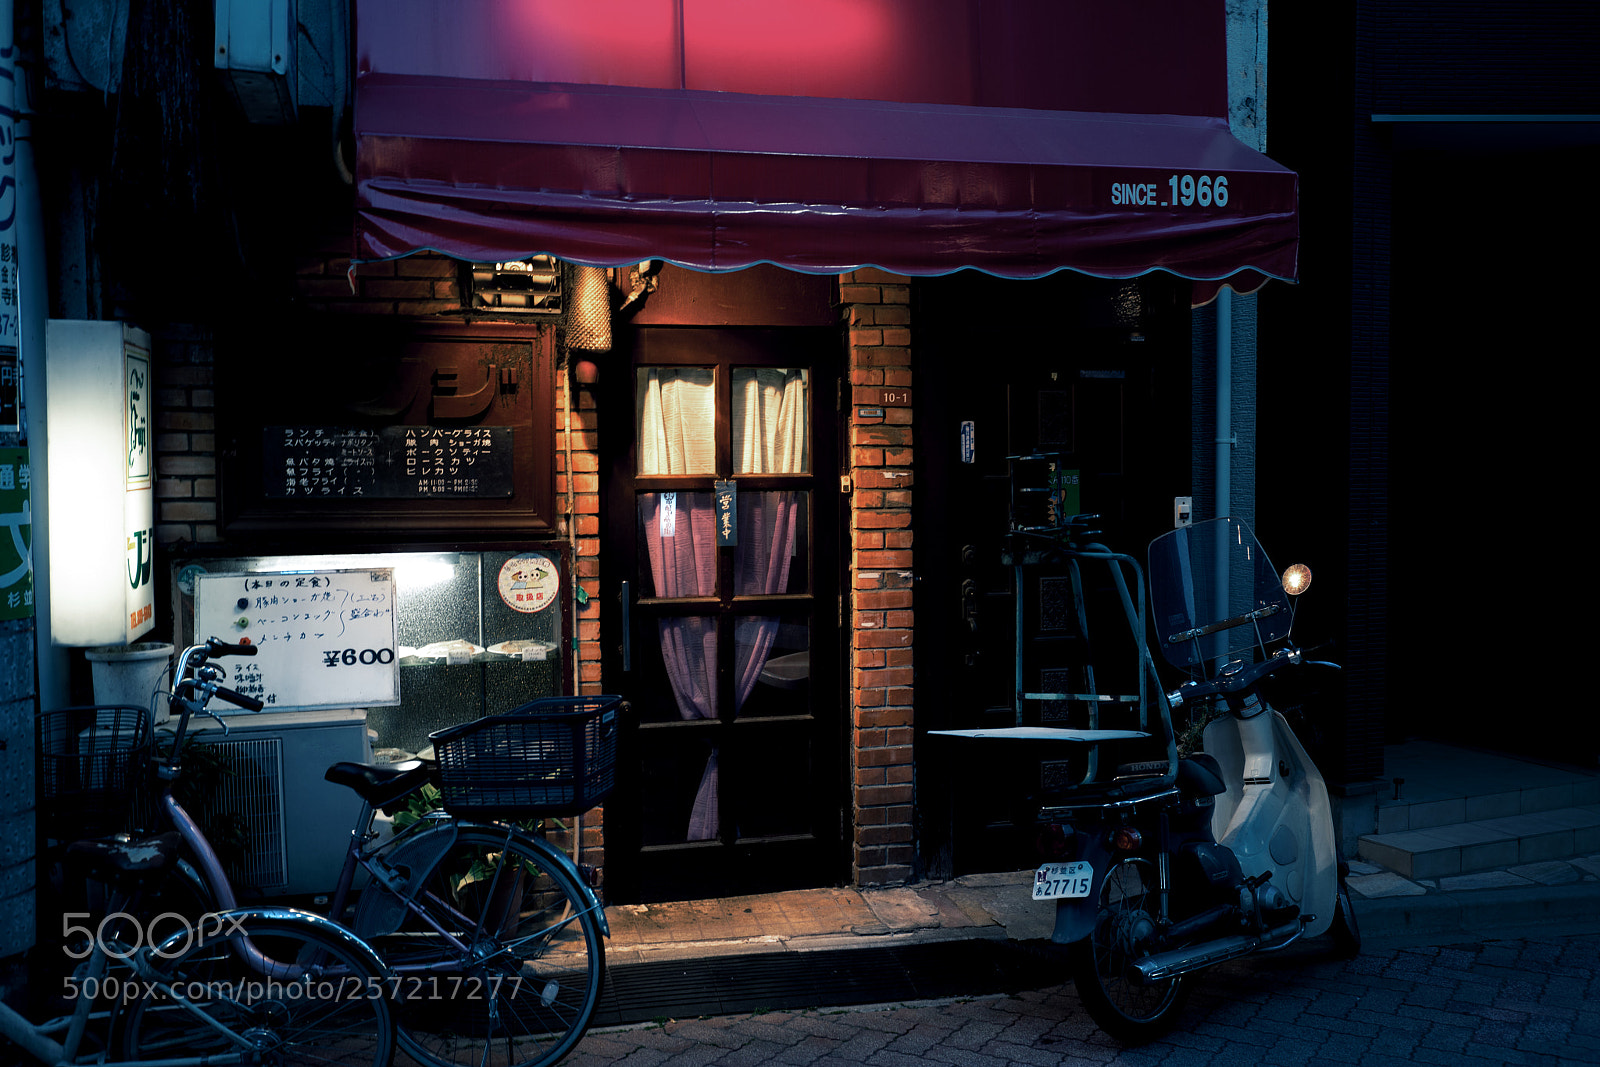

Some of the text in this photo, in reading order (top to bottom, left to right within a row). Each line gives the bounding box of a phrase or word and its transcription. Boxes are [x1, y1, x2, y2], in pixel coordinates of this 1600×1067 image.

[1111, 174, 1229, 207] SINCE 1966
[883, 393, 907, 403] 10-1
[405, 429, 492, 438] ハンバーグライス
[406, 457, 476, 466] ロースカツ
[719, 494, 733, 540] 営業中
[322, 648, 395, 667] ¥600
[1131, 763, 1170, 772] HONDA
[1044, 878, 1089, 896] 27715
